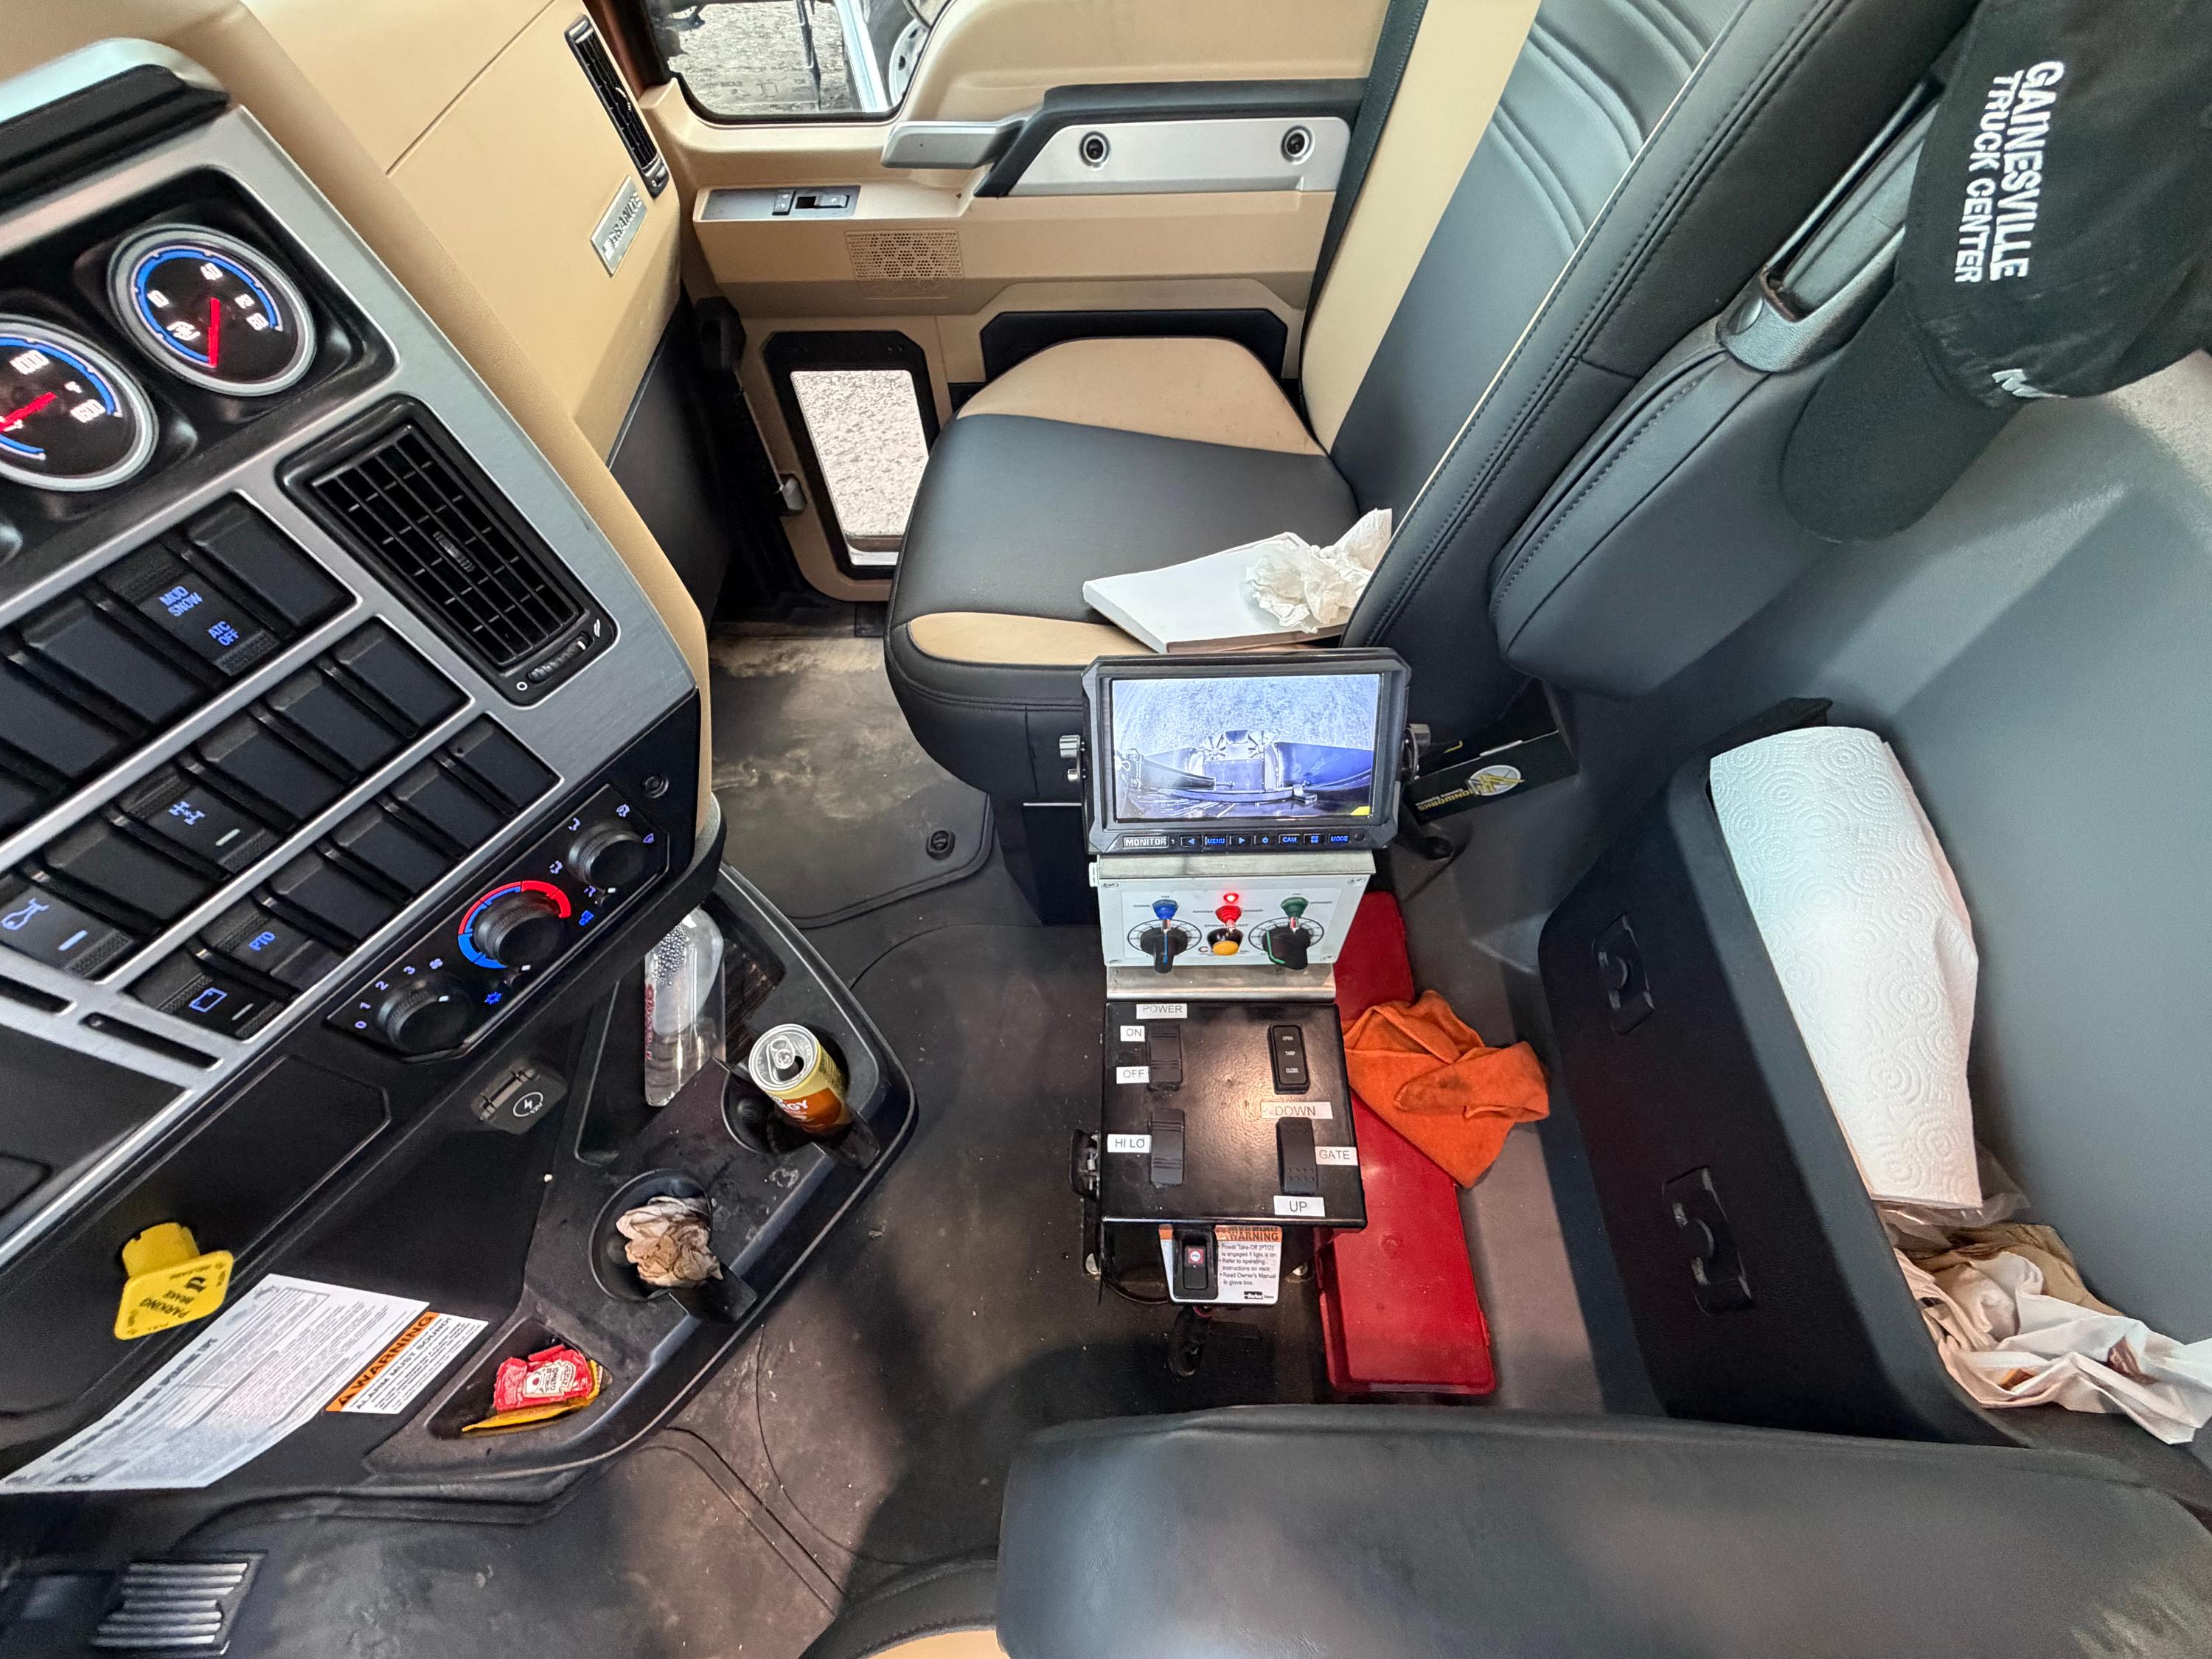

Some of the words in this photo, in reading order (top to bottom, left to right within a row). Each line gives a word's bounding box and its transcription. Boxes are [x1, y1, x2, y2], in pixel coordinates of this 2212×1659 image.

[1969, 70, 2025, 173] TRUCK
[1990, 60, 2065, 282] GAINESVILLE
[1955, 177, 1997, 284] CENTER
[1125, 837, 1166, 847] MONITOR
[248, 931, 276, 951] PTO
[403, 966, 416, 975] 3
[375, 981, 389, 991] 2
[1142, 1004, 1183, 1014] POWER
[355, 1020, 367, 1030] 0
[1125, 1028, 1142, 1037] ON
[1123, 1069, 1145, 1079] OFF
[1275, 1105, 1316, 1116] DOWN
[1114, 1138, 1126, 1148] HI
[1130, 1138, 1145, 1149] LO
[1318, 1150, 1351, 1161] GATE
[1289, 1201, 1307, 1213] UP
[1228, 1232, 1279, 1241] WARNING
[139, 1297, 190, 1318] PARKING
[351, 1316, 433, 1390] WARNING
